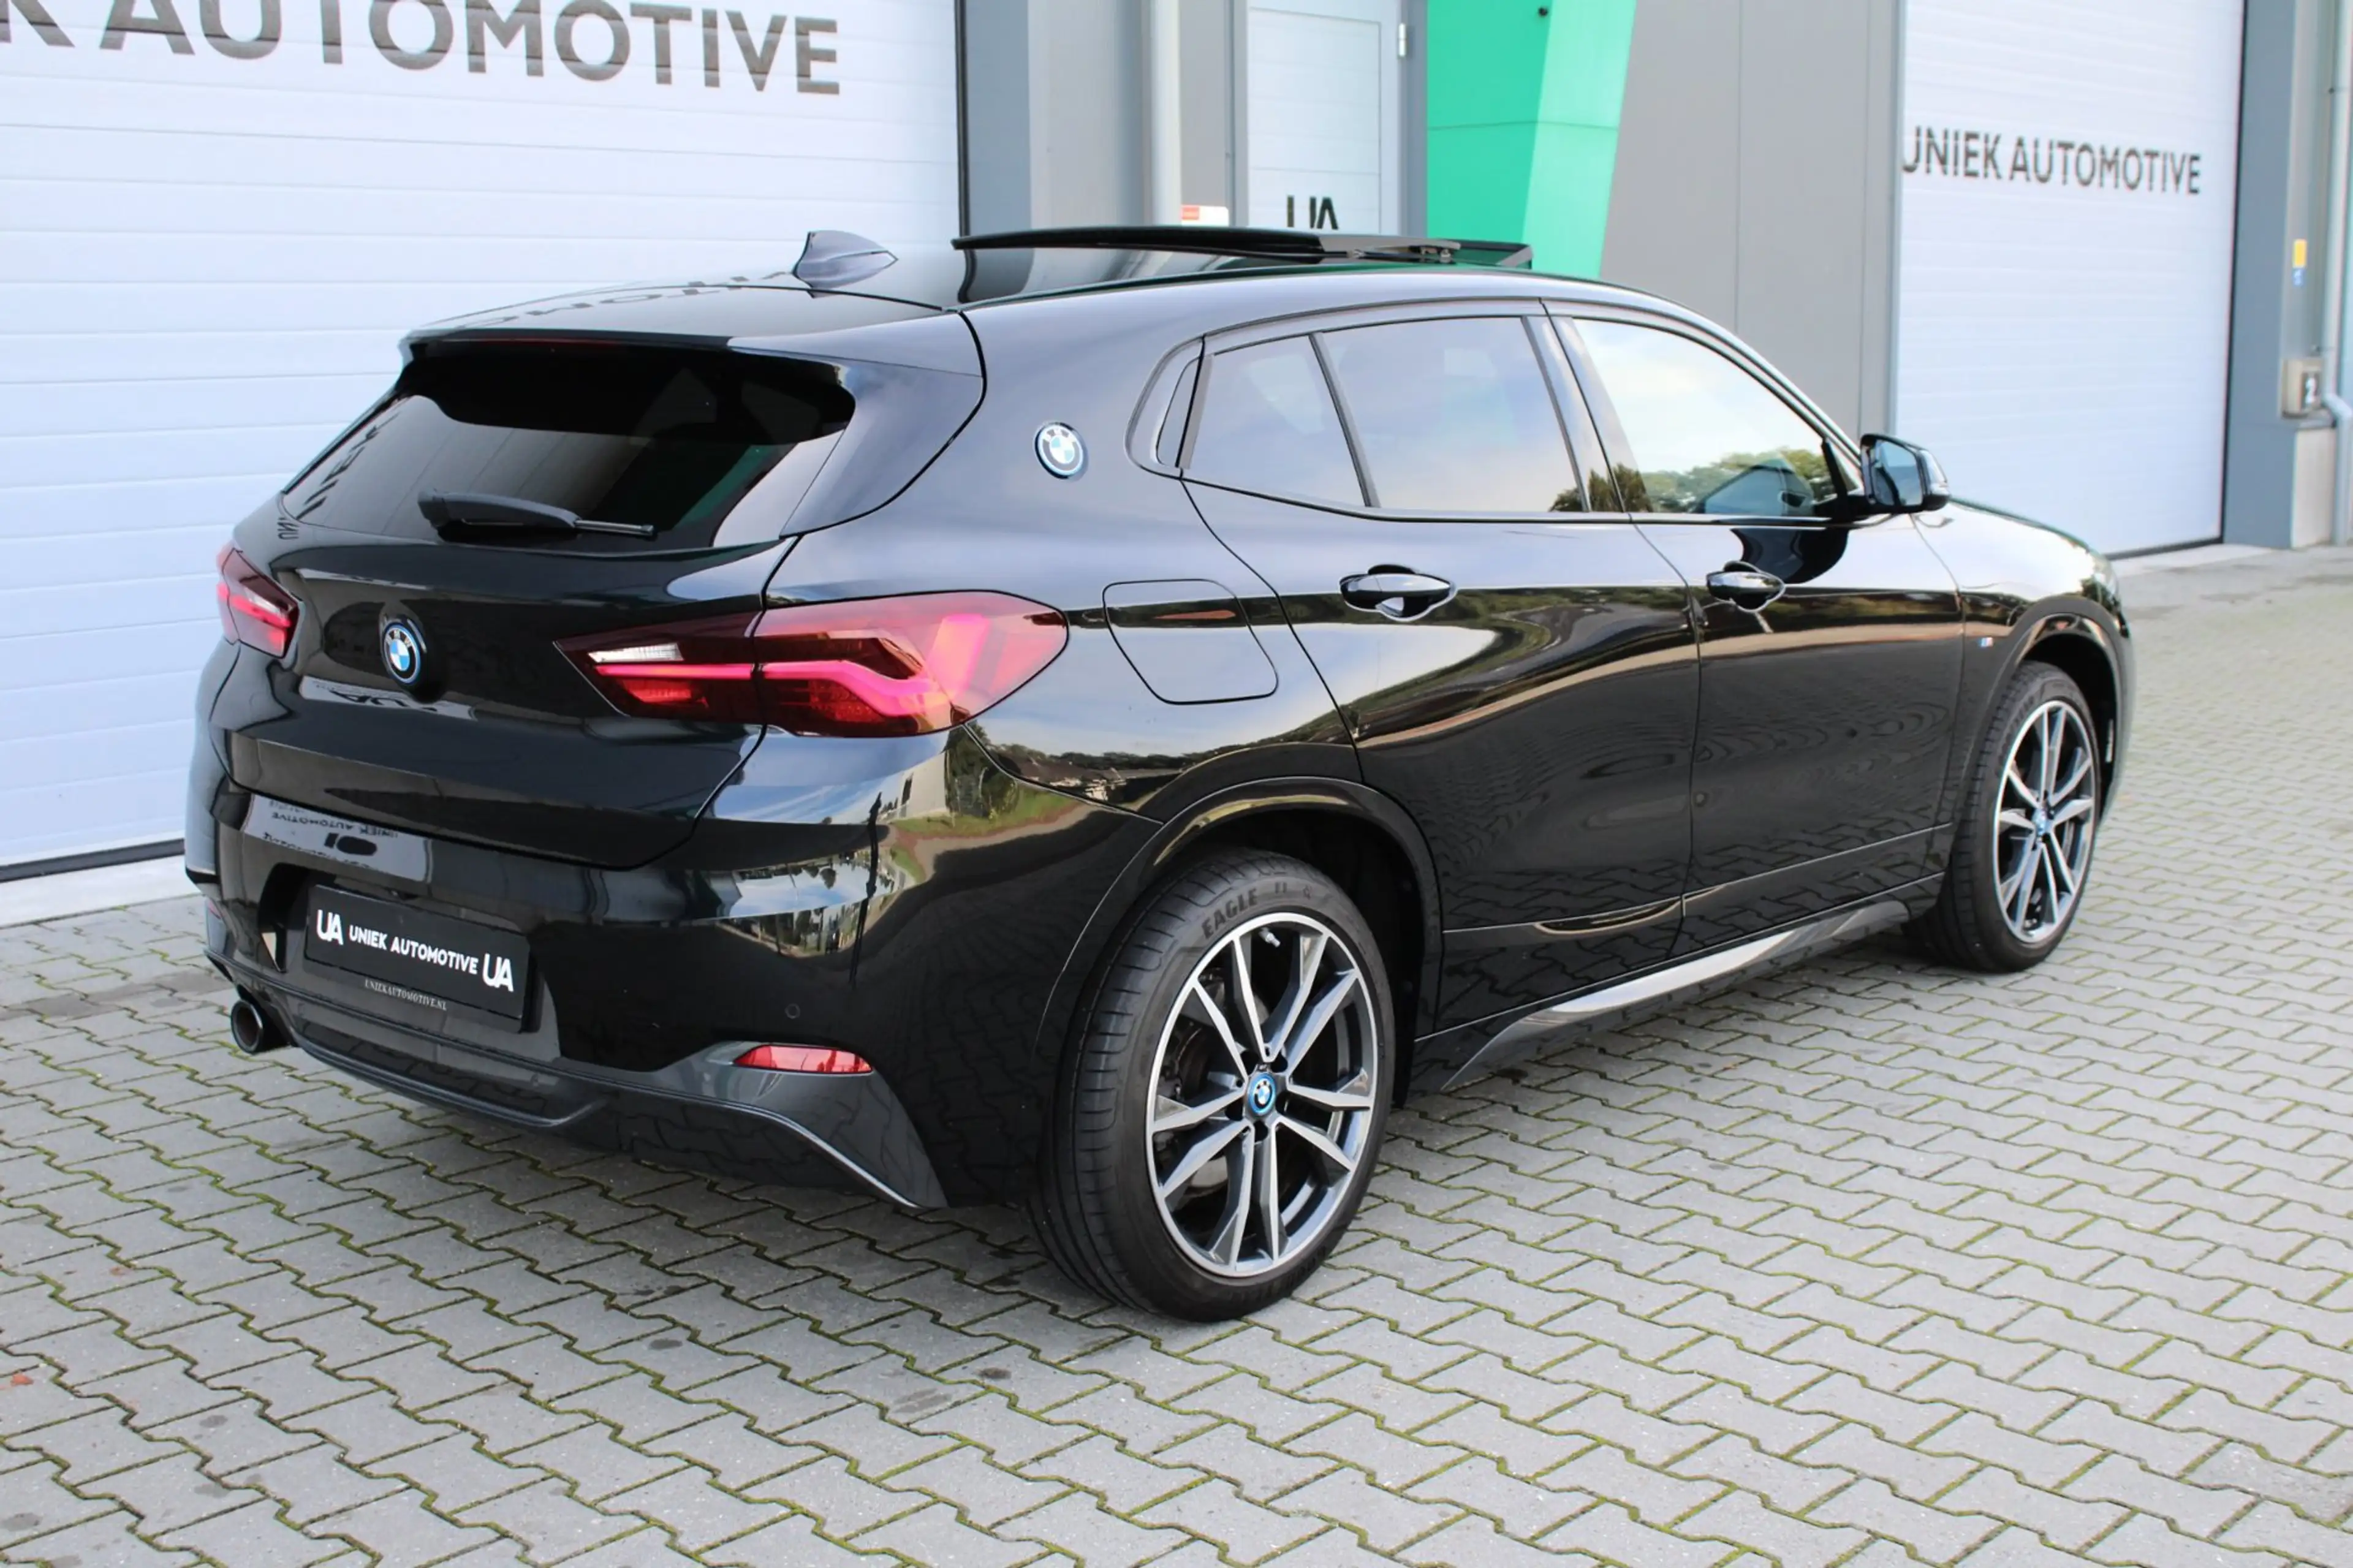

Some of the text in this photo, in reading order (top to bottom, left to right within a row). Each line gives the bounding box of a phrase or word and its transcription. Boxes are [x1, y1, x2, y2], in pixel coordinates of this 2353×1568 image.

[2010, 135, 2201, 195] AUTOMOTIVE
[1201, 887, 1259, 940] EAGLE
[316, 909, 514, 993] UA UNIEK AUTOMOTIVE UA
[365, 978, 447, 1012] UNIEKAUTOMOTIVE.NL
